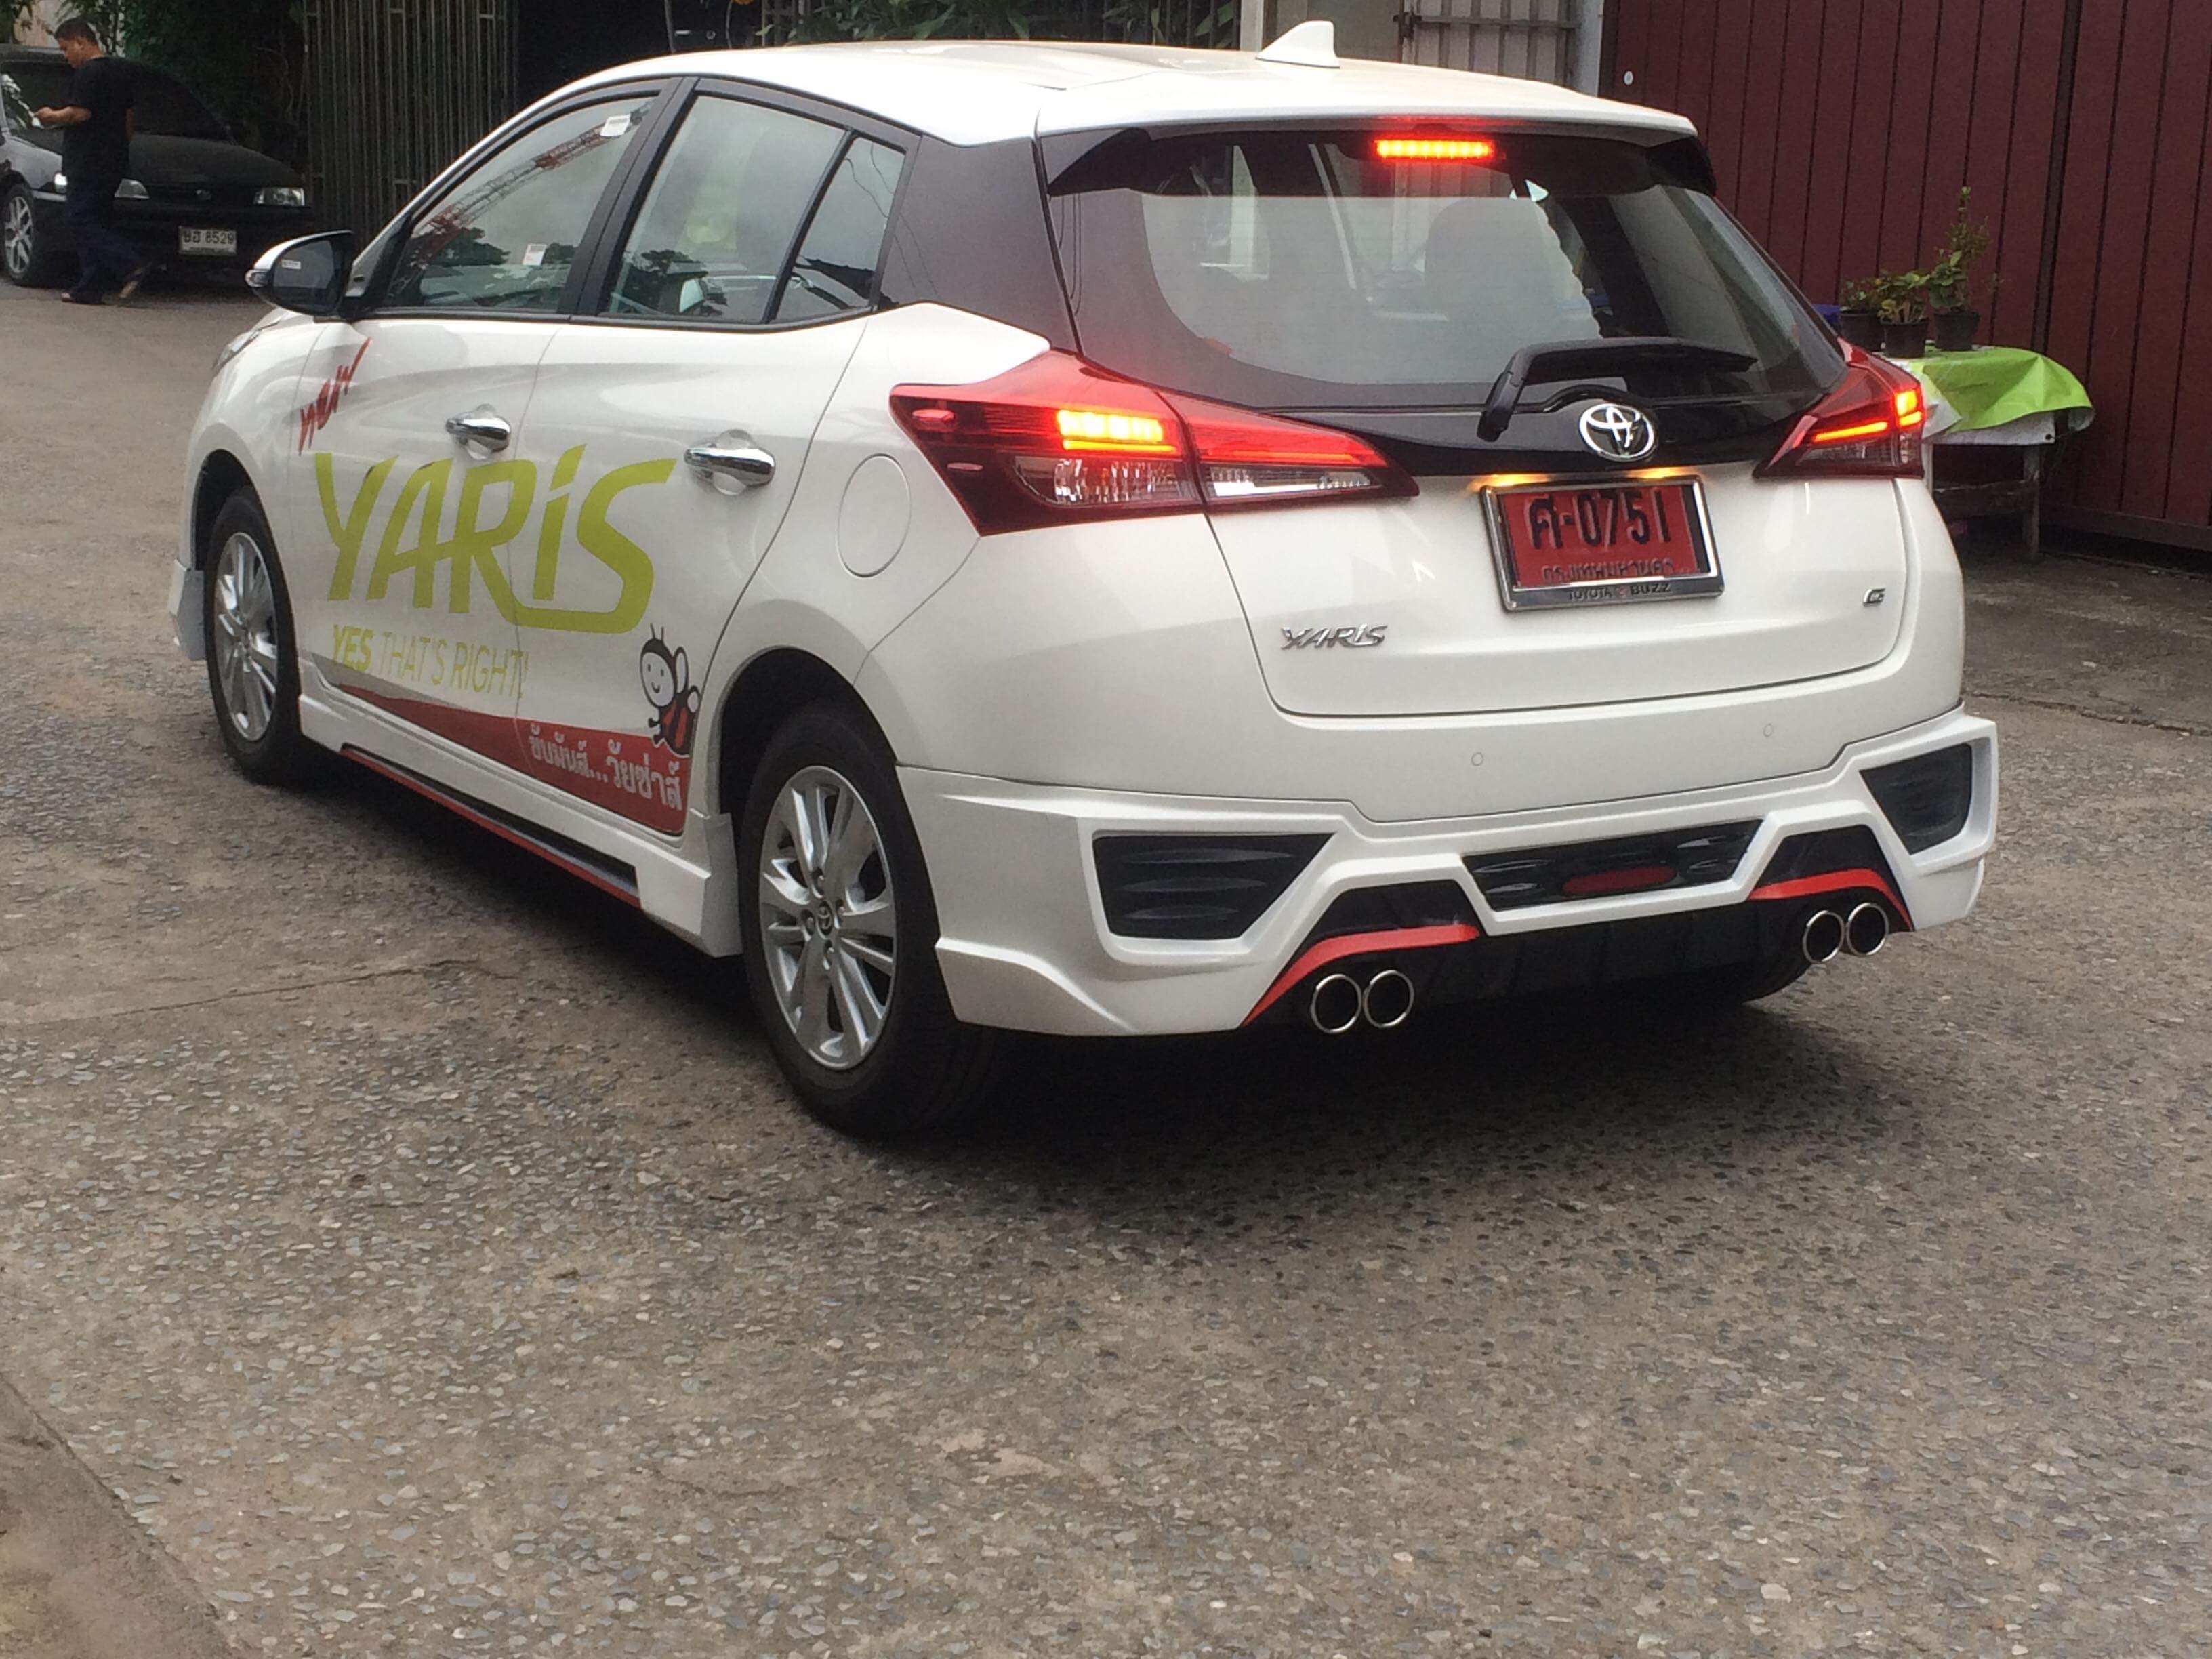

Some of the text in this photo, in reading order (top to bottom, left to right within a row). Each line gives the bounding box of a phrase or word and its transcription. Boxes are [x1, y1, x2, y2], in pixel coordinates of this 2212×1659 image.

[314, 444, 677, 634] YARIS
[1568, 582, 1672, 601] TOYOTA BUZZ
[333, 624, 529, 699] YES THAT'S RIGHT!
[1281, 623, 1387, 650] YARIS
